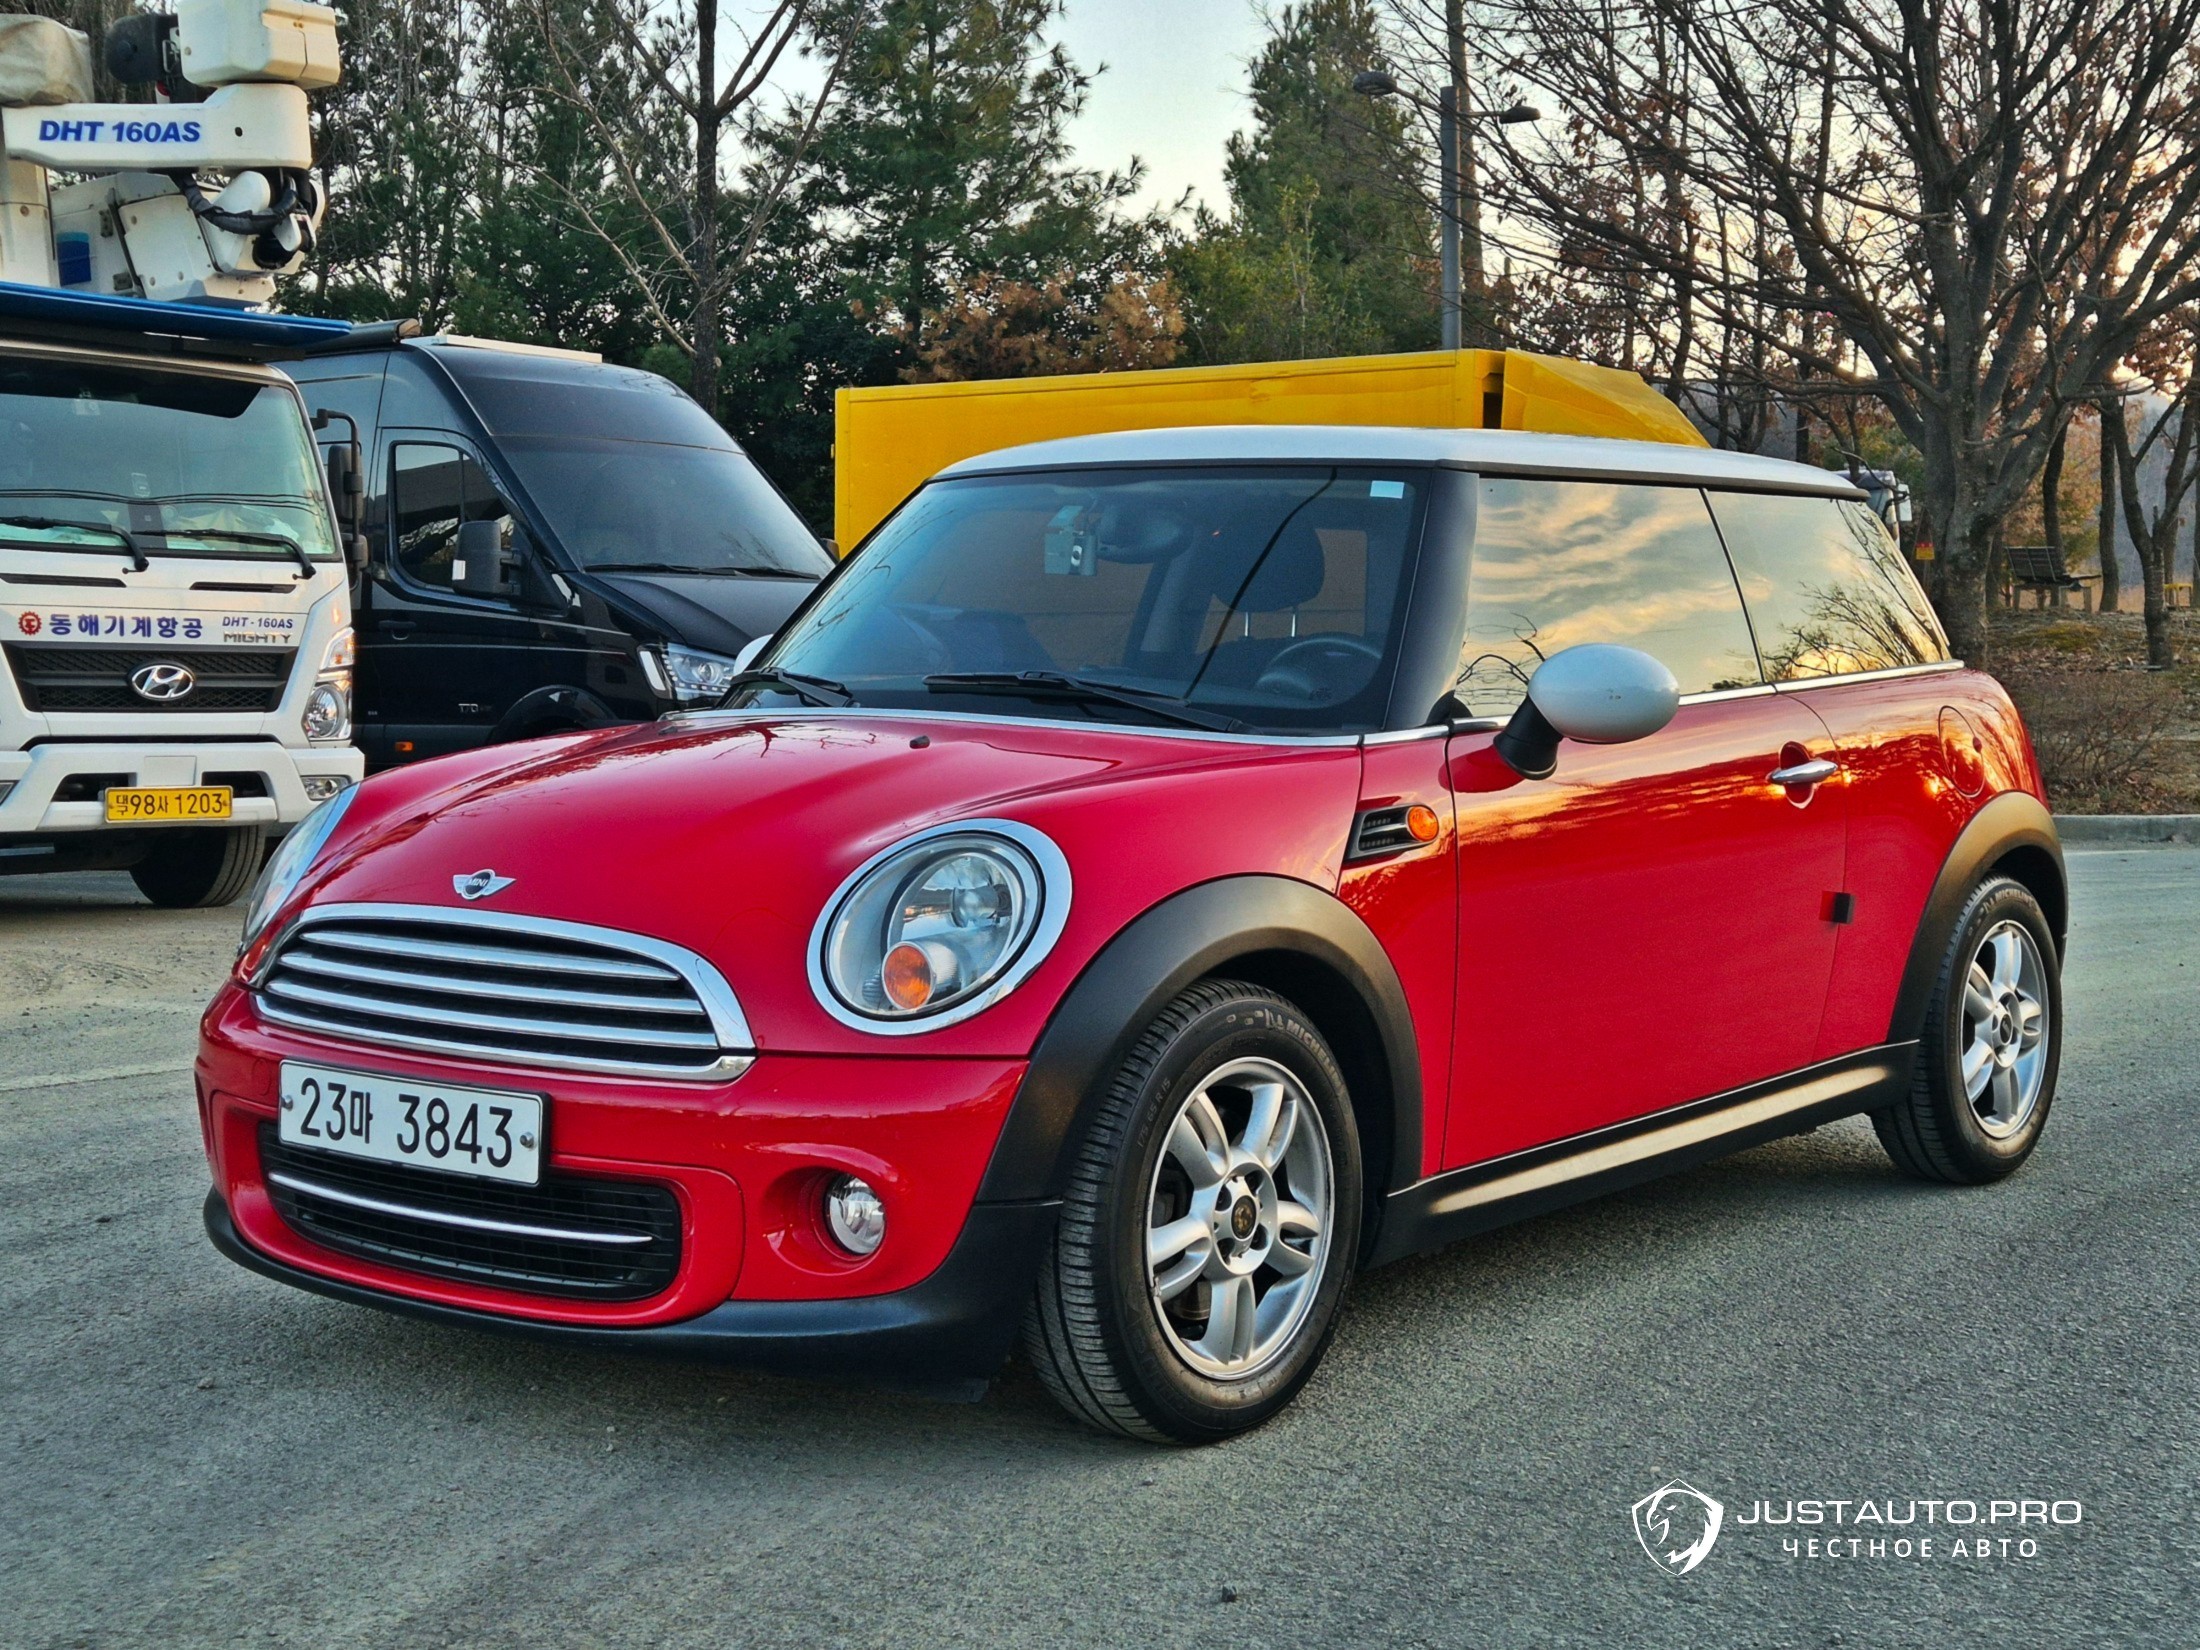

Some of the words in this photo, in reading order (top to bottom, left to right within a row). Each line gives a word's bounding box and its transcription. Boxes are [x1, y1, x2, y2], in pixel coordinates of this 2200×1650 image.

[38, 120, 104, 142] DHT
[111, 121, 201, 143] 160AS
[48, 614, 204, 639] 동해기계항공
[223, 631, 293, 644] MIGHTY
[174, 793, 223, 814] 1203
[300, 1077, 373, 1144] 23마
[396, 1093, 513, 1168] 3843
